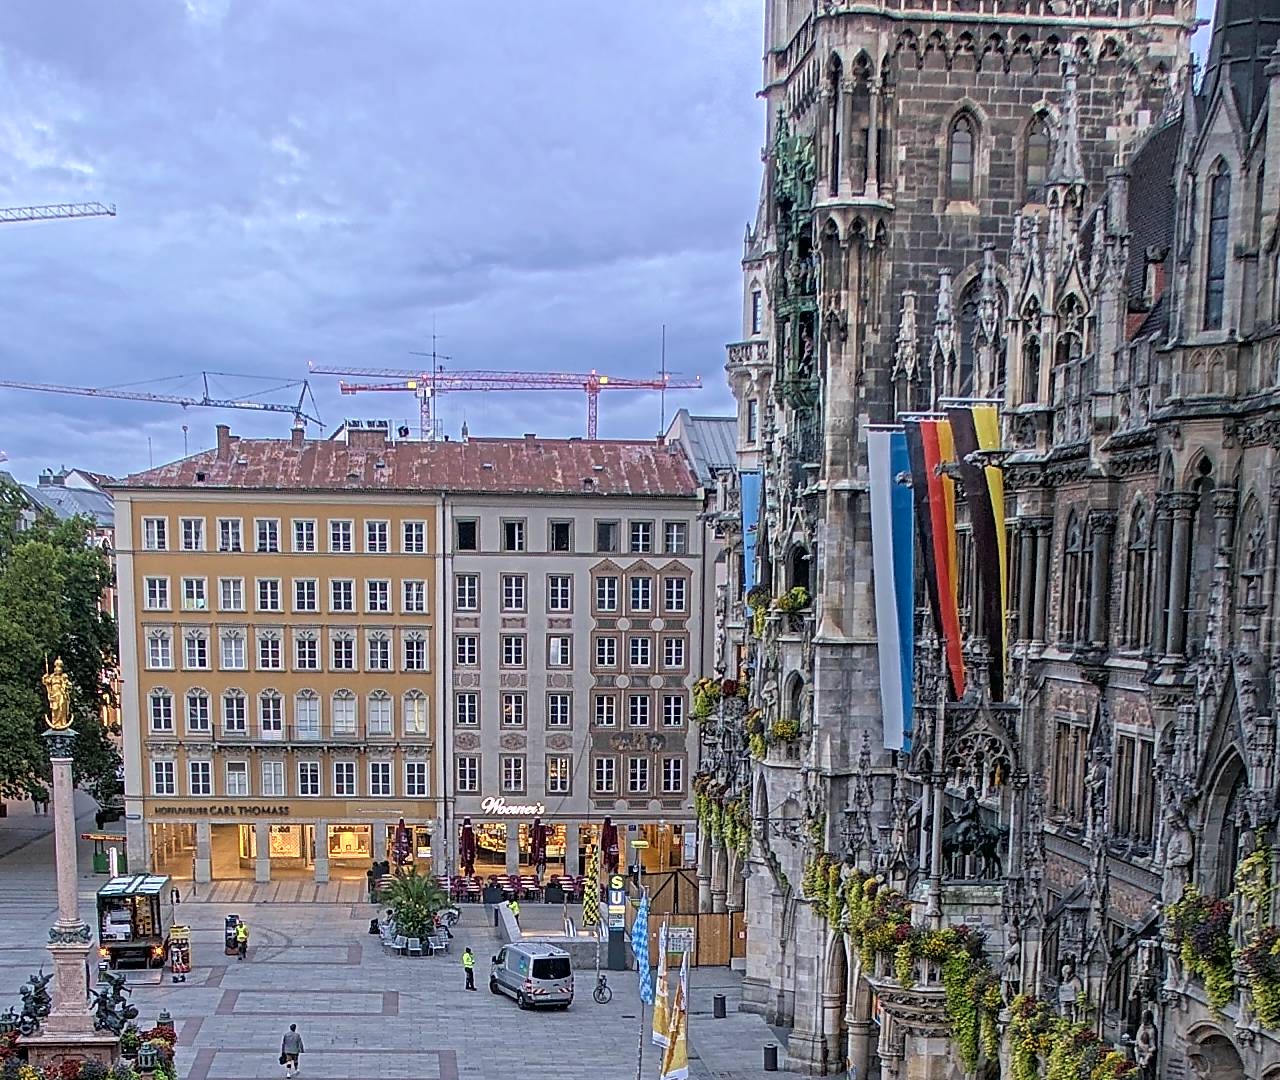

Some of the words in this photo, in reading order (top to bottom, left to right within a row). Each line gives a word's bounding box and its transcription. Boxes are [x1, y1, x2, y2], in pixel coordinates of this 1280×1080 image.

[209, 805, 236, 816] CARL
[237, 805, 290, 816] THOMASS
[611, 876, 624, 889] S
[611, 892, 622, 904] U
